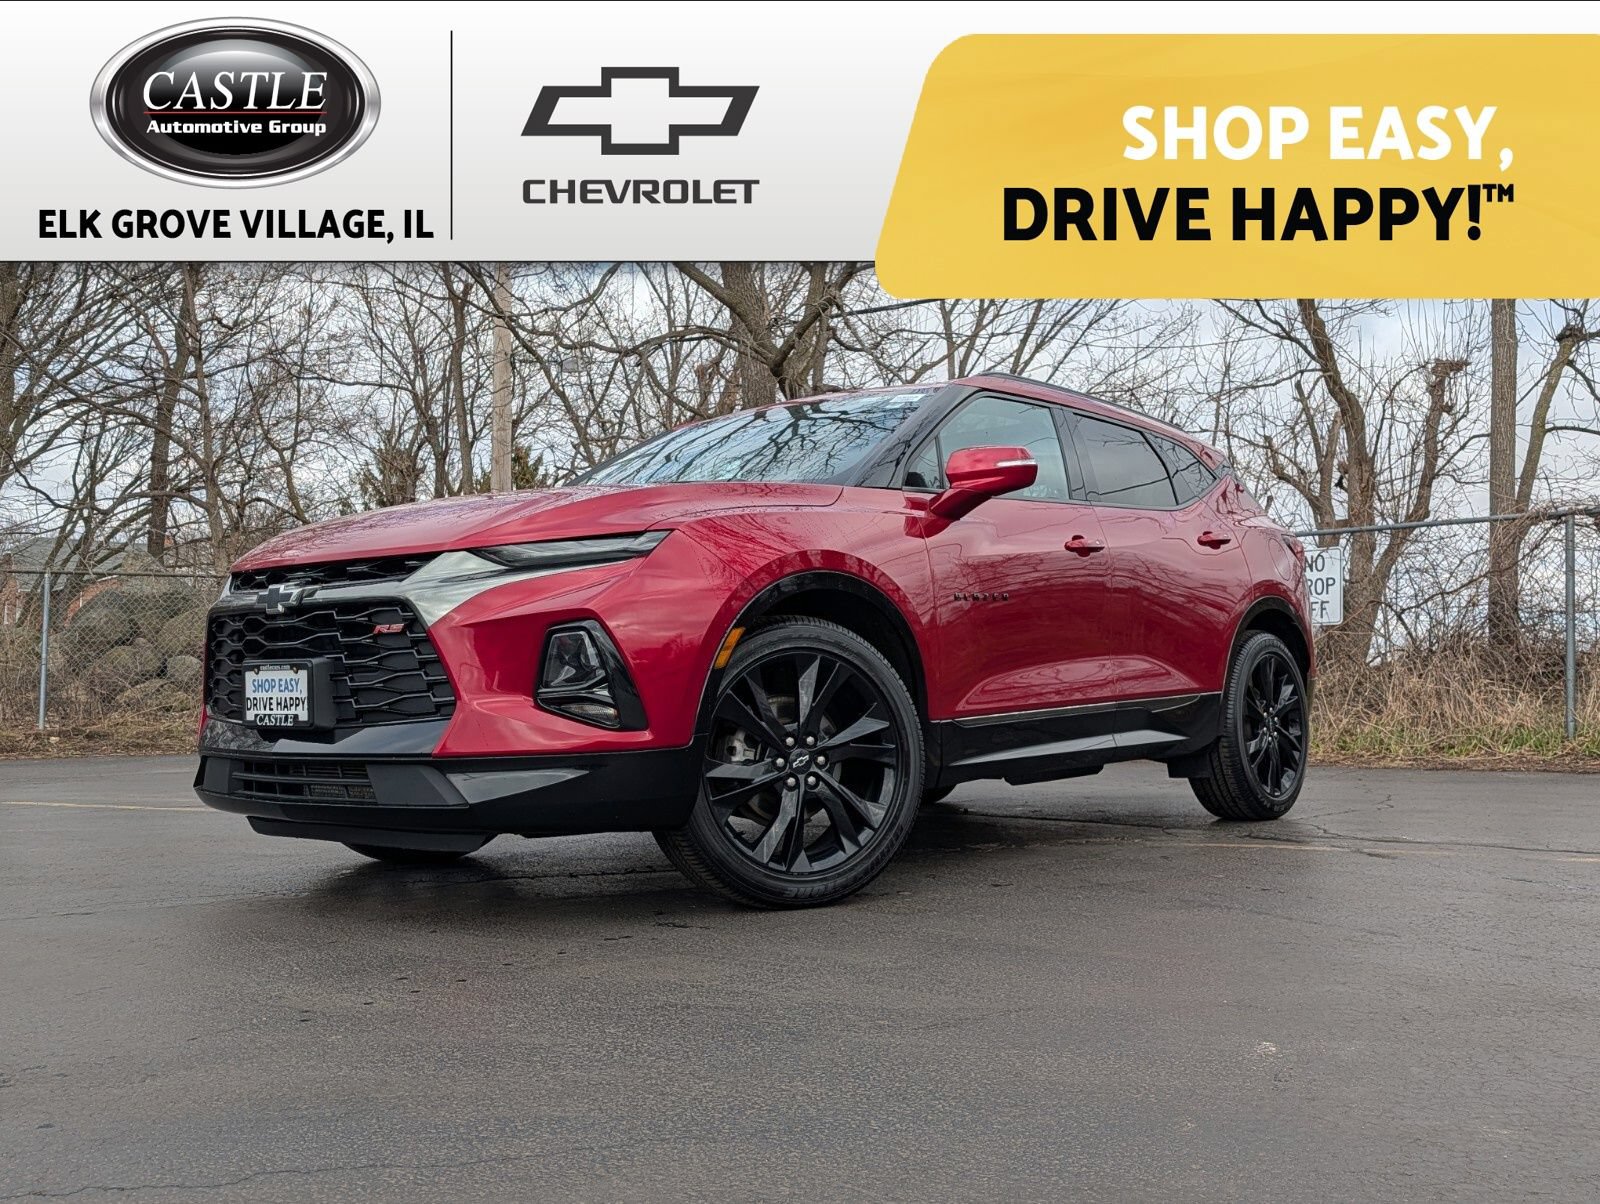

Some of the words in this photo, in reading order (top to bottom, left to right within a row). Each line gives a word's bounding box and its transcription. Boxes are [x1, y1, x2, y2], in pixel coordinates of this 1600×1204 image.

[1304, 554, 1326, 573] NO
[1308, 577, 1336, 596] ROP
[1311, 600, 1330, 619] FF
[252, 678, 277, 693] SHOP
[278, 677, 303, 694] EASY,
[246, 696, 274, 711] DRIVE
[256, 714, 295, 726] CASTLE
